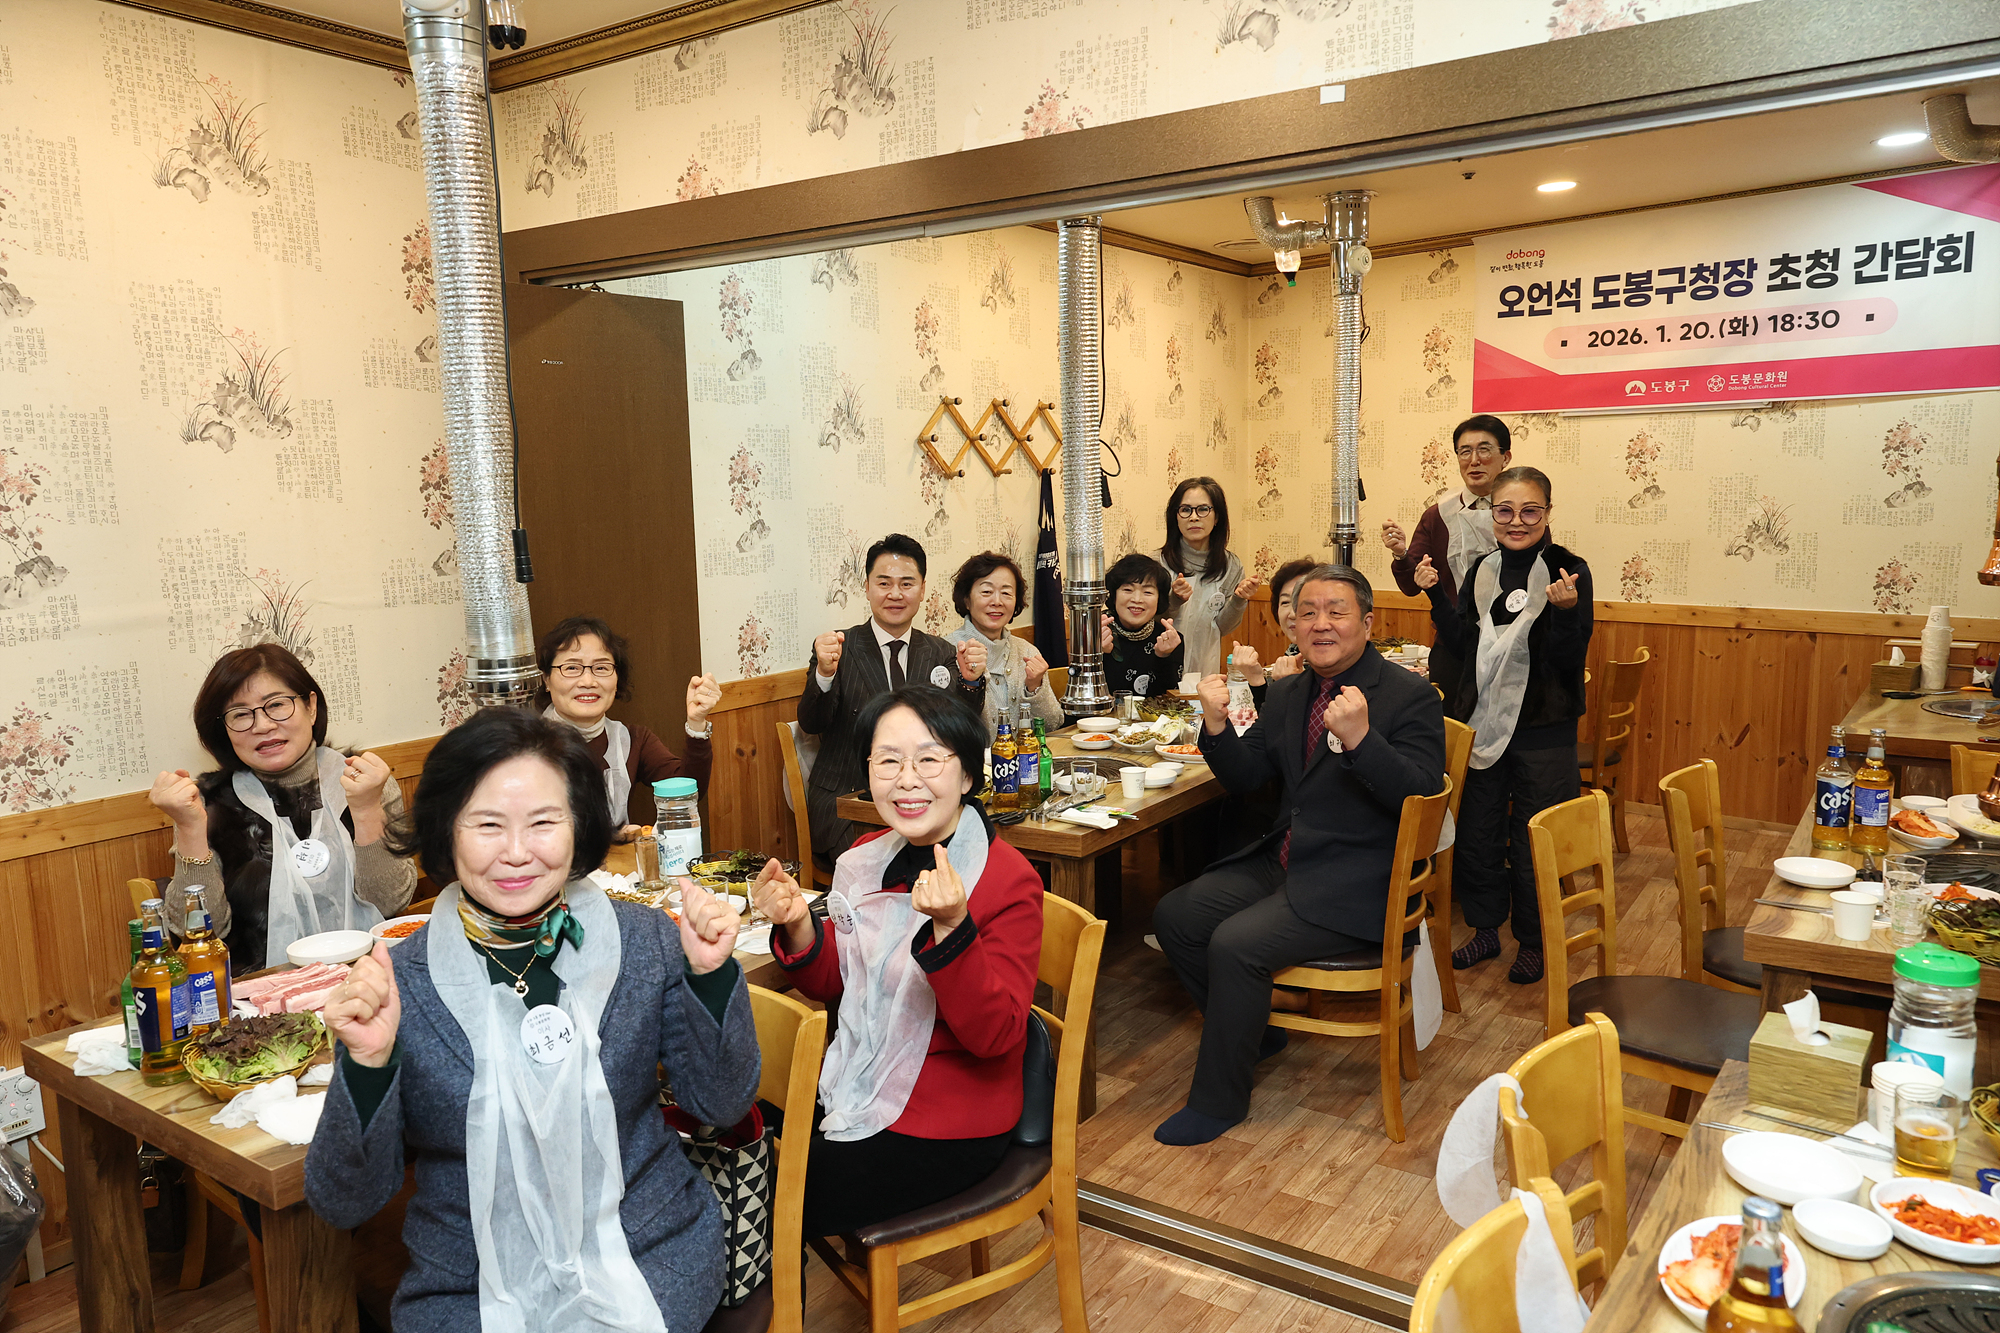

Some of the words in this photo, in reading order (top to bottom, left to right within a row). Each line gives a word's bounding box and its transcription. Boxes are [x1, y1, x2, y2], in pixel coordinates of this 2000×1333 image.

[1506, 249, 1545, 260] dobong
[1497, 277, 1582, 319] 오언석
[1591, 257, 1758, 310] 도봉구청장
[1766, 247, 1841, 293] 초청
[1853, 230, 1975, 285] 간담회
[1587, 326, 1648, 348] 2026.
[1656, 325, 1671, 343] 1.
[1767, 309, 1840, 333] 18:30
[1651, 379, 1691, 393] 도봉구
[1729, 371, 1788, 385] 도봉문화원
[529, 1027, 573, 1056] 최금선
